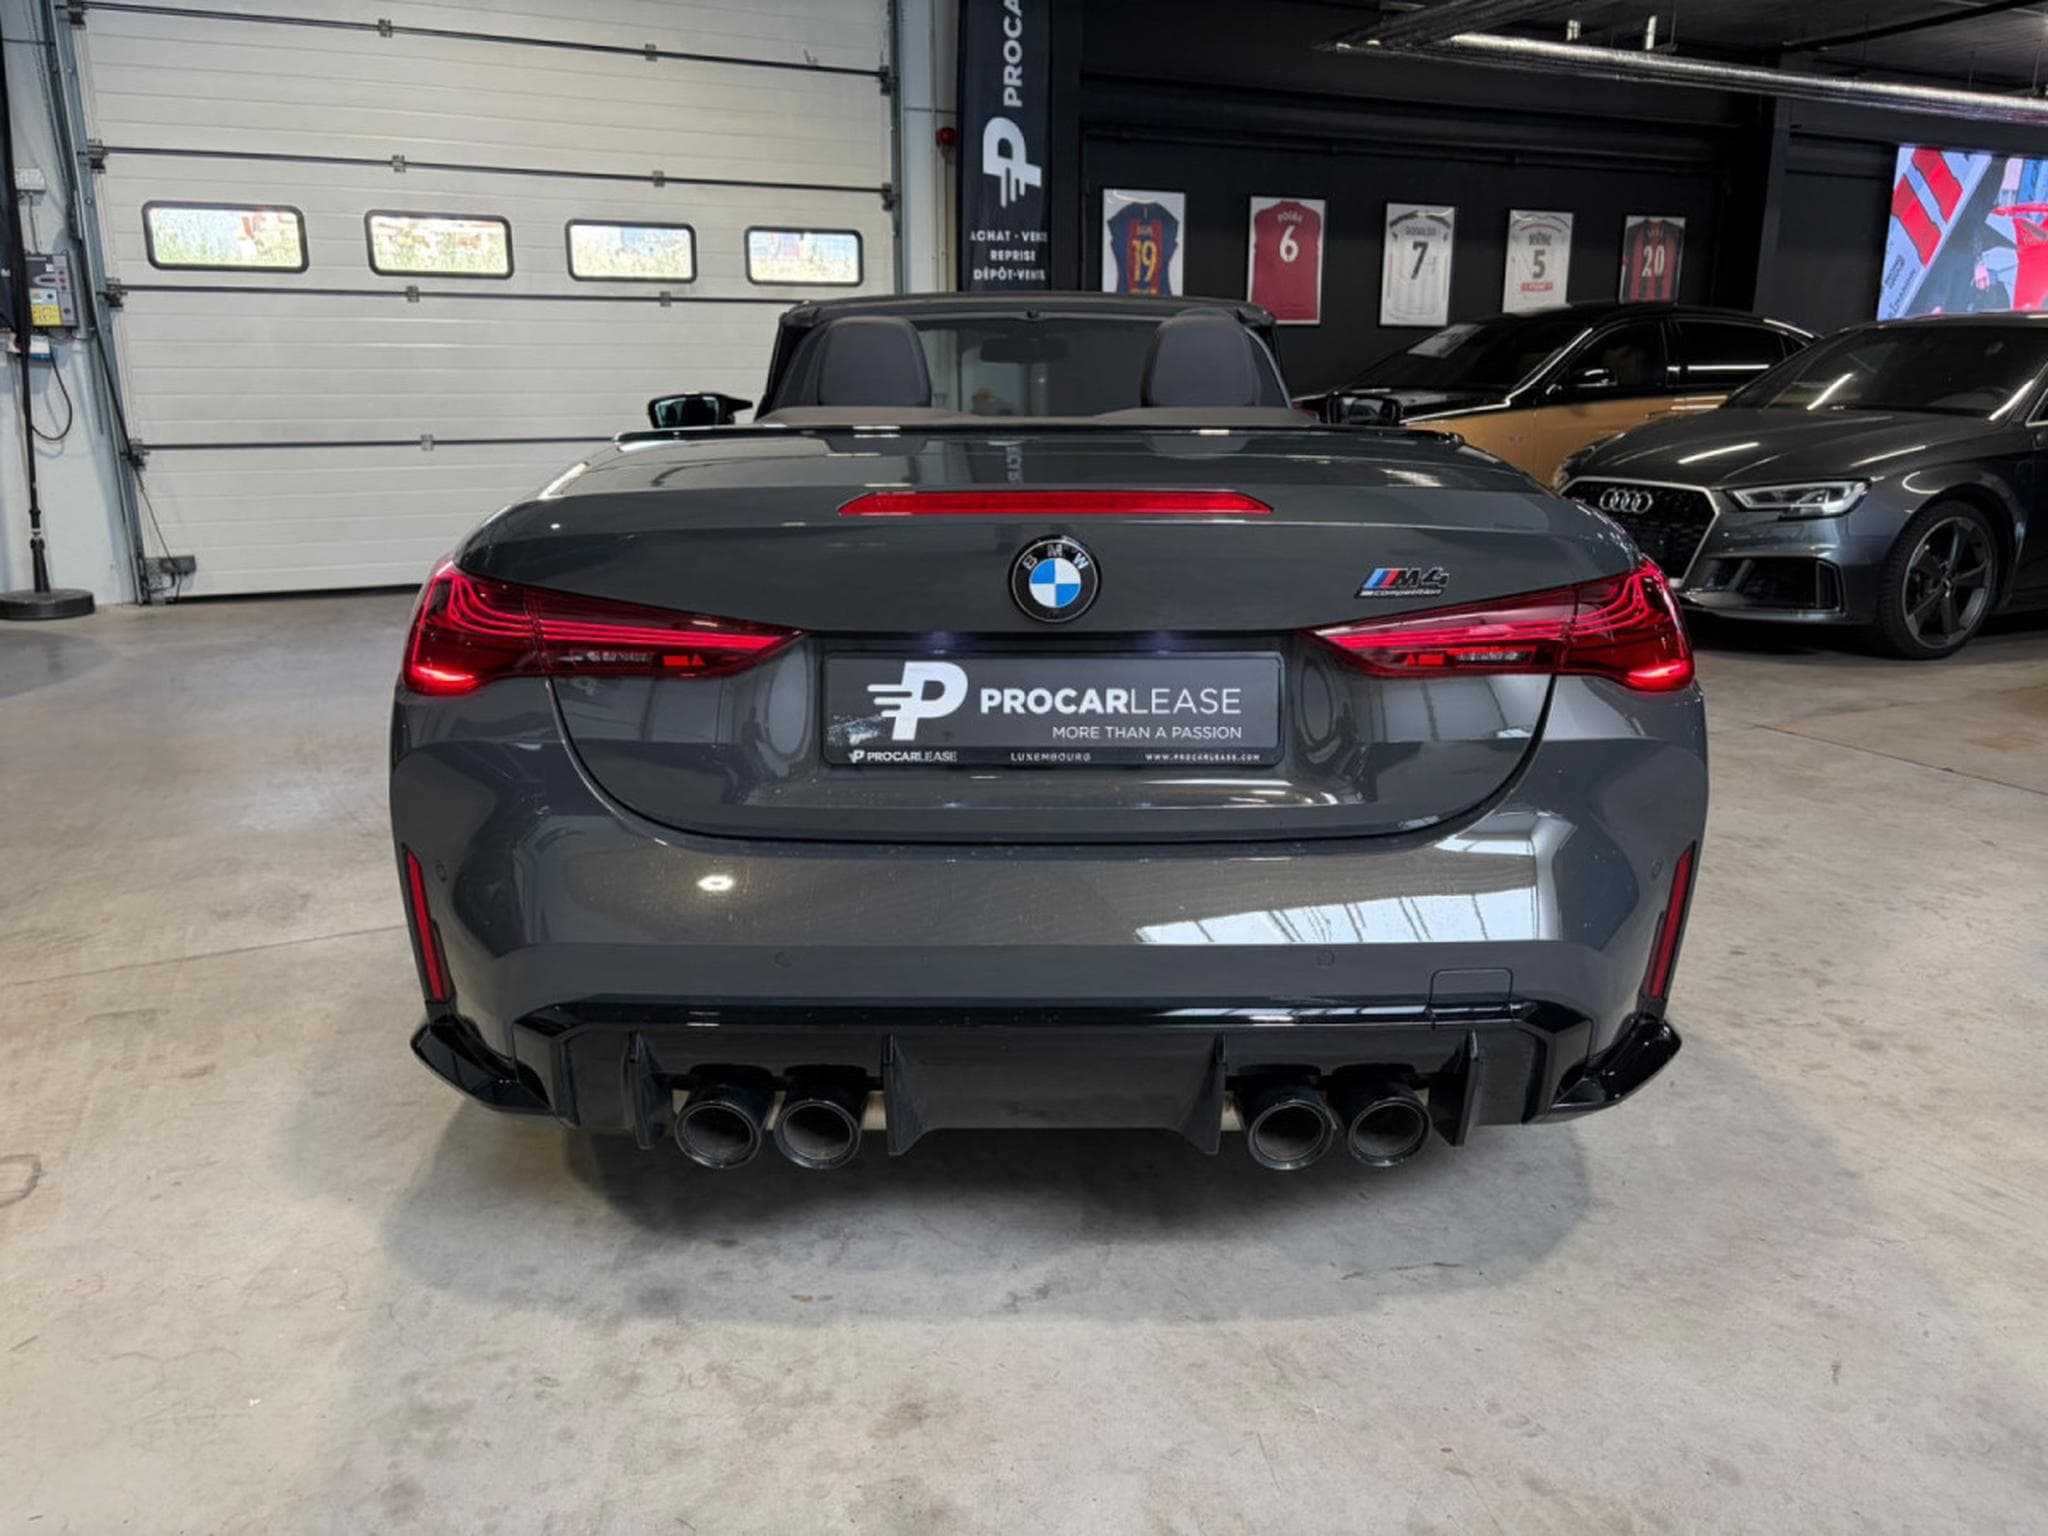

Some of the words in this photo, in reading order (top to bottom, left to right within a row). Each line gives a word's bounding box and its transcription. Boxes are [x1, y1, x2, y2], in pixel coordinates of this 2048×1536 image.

[970, 230, 1011, 242] ACHAT
[1279, 224, 1299, 262] 6
[990, 249, 1036, 261] REPRISE
[1132, 240, 1158, 282] 19
[1411, 241, 1429, 280] 7
[1532, 249, 1546, 279] 5
[1641, 245, 1666, 278] 20
[1022, 544, 1089, 570] BMW
[1382, 567, 1450, 589] M4
[980, 687, 1242, 715] PROCARLEASE
[1052, 726, 1100, 740] MORE
[1105, 726, 1150, 740] THAN
[1154, 726, 1168, 740] A
[1171, 725, 1243, 741] PASSION
[867, 751, 957, 762] PROCARLEASE
[1010, 753, 1091, 762] LUXEMBOURG
